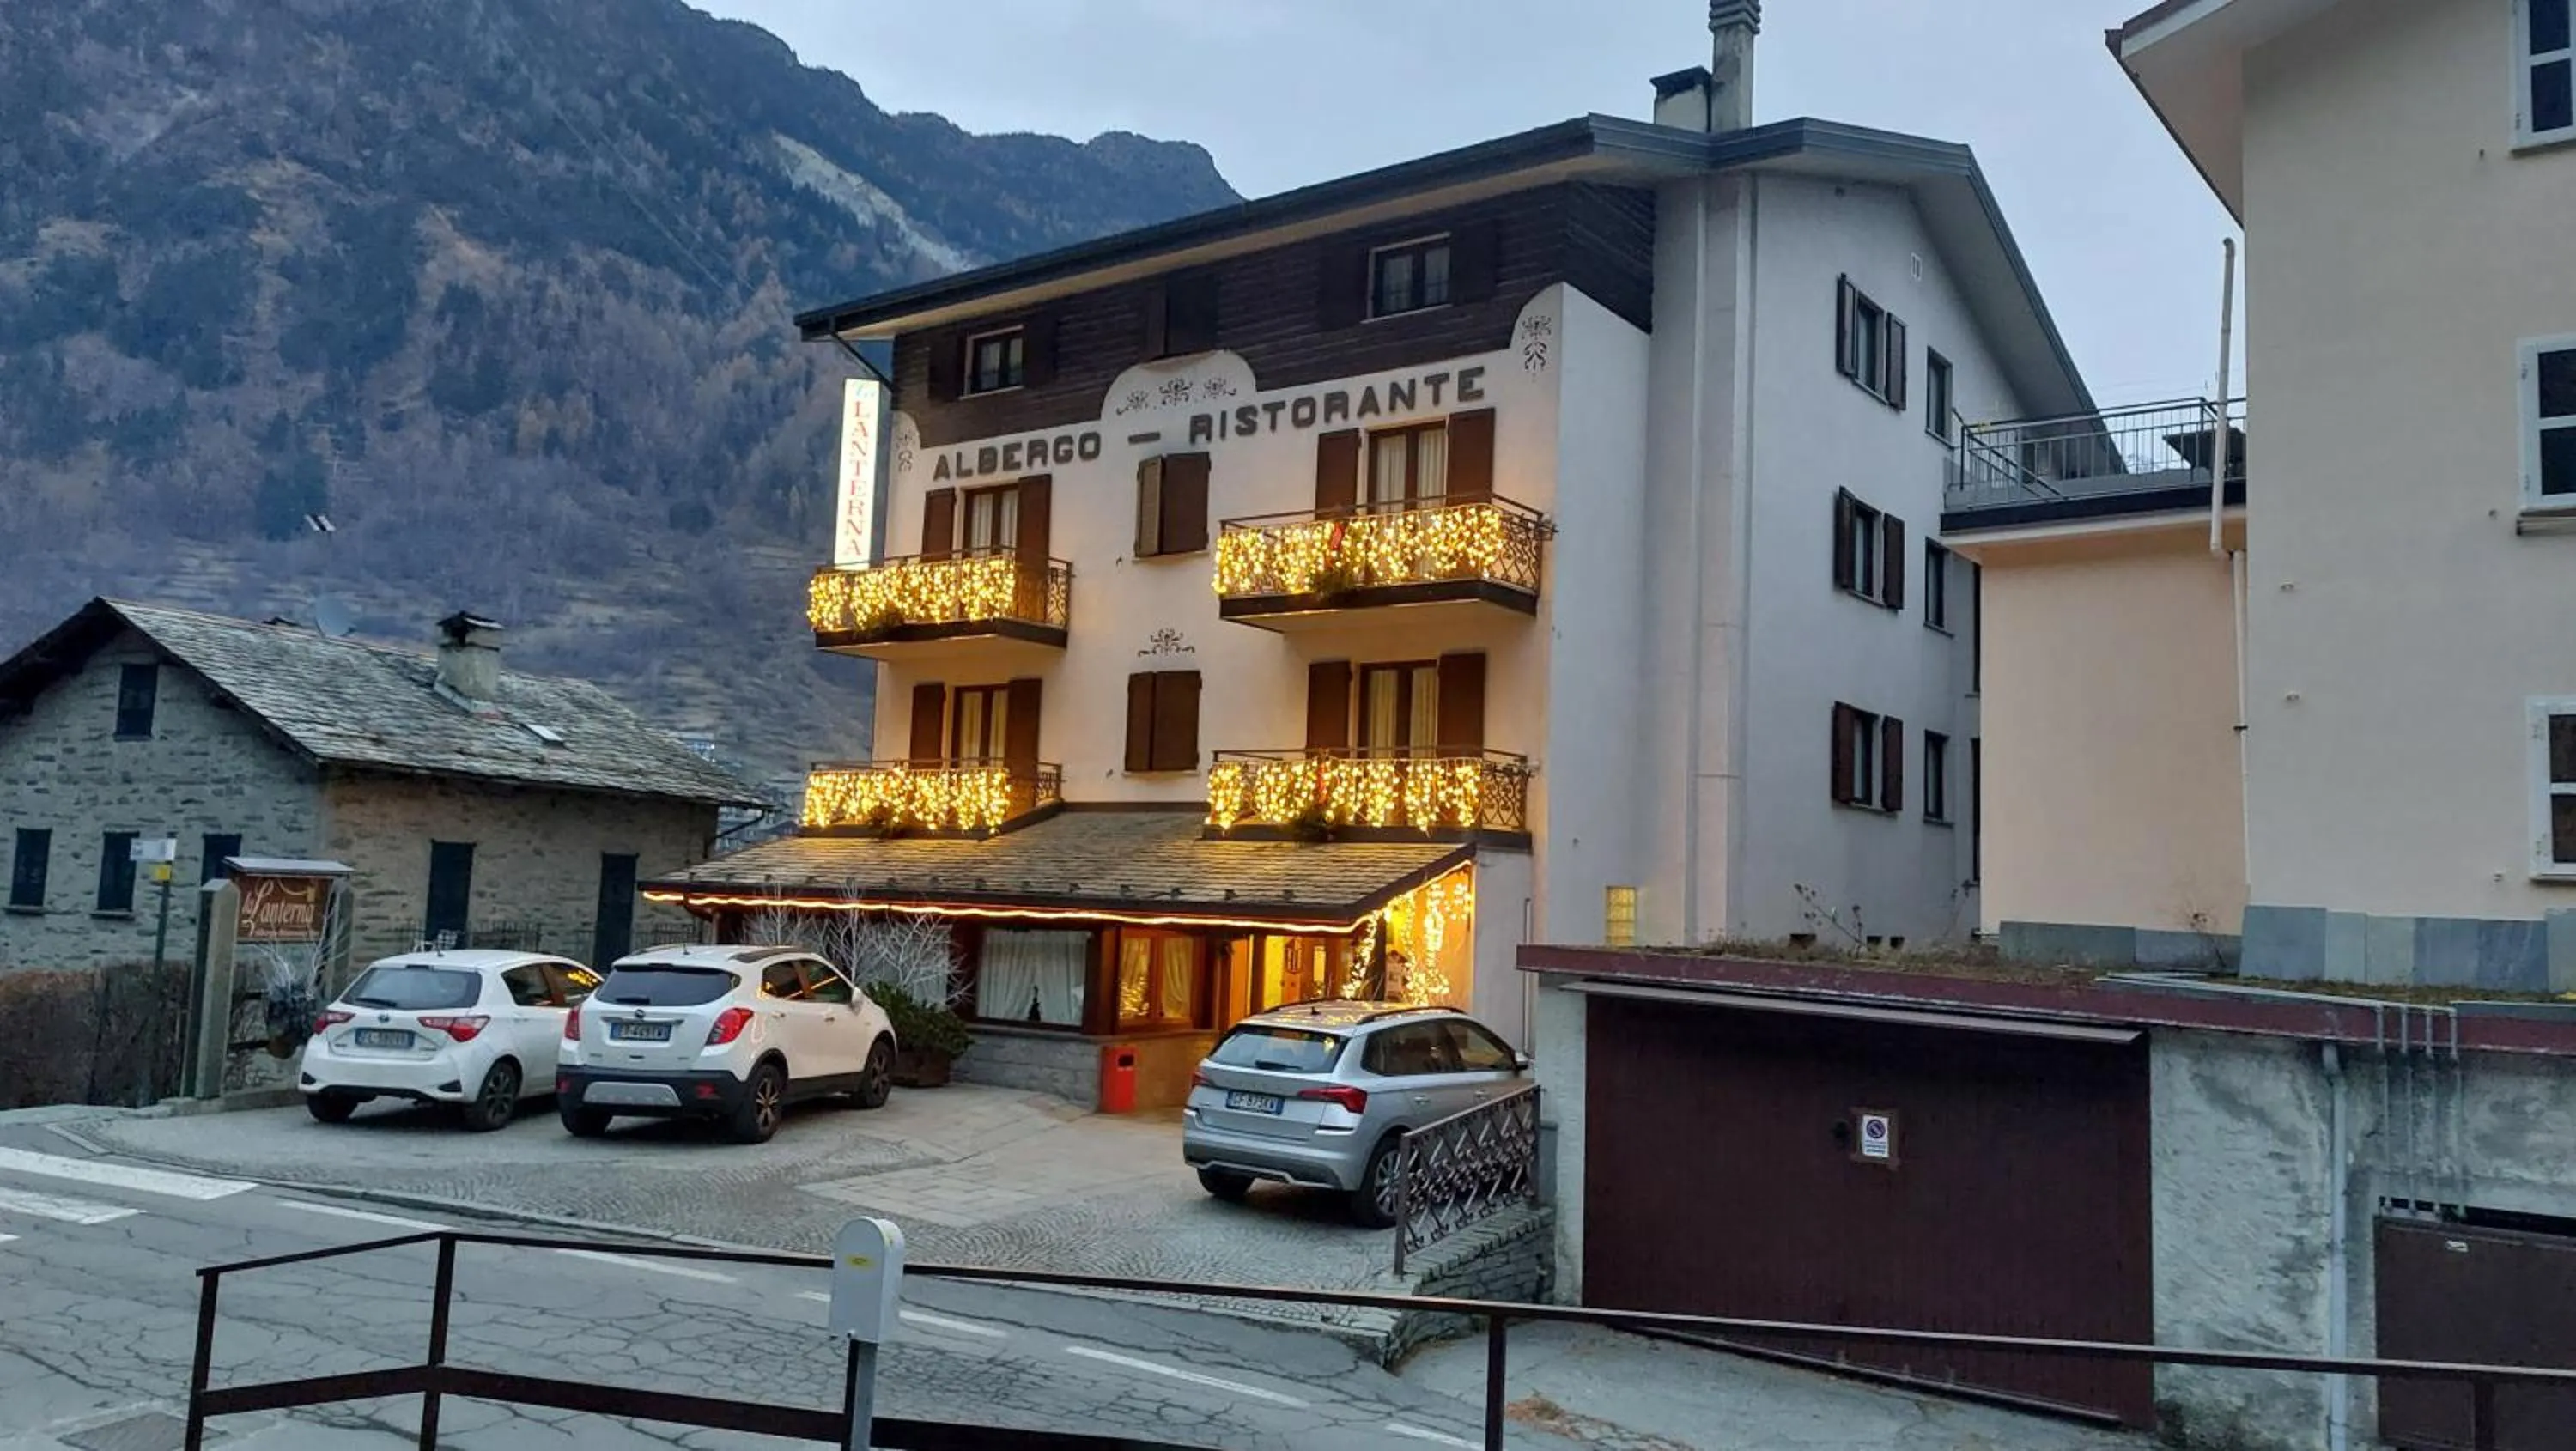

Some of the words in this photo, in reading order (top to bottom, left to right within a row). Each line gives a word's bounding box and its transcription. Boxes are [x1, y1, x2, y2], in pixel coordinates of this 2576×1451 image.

[842, 400, 871, 556] LANTERNA
[933, 432, 1101, 482] ALBERGO
[1189, 366, 1485, 445] RISTORANTE
